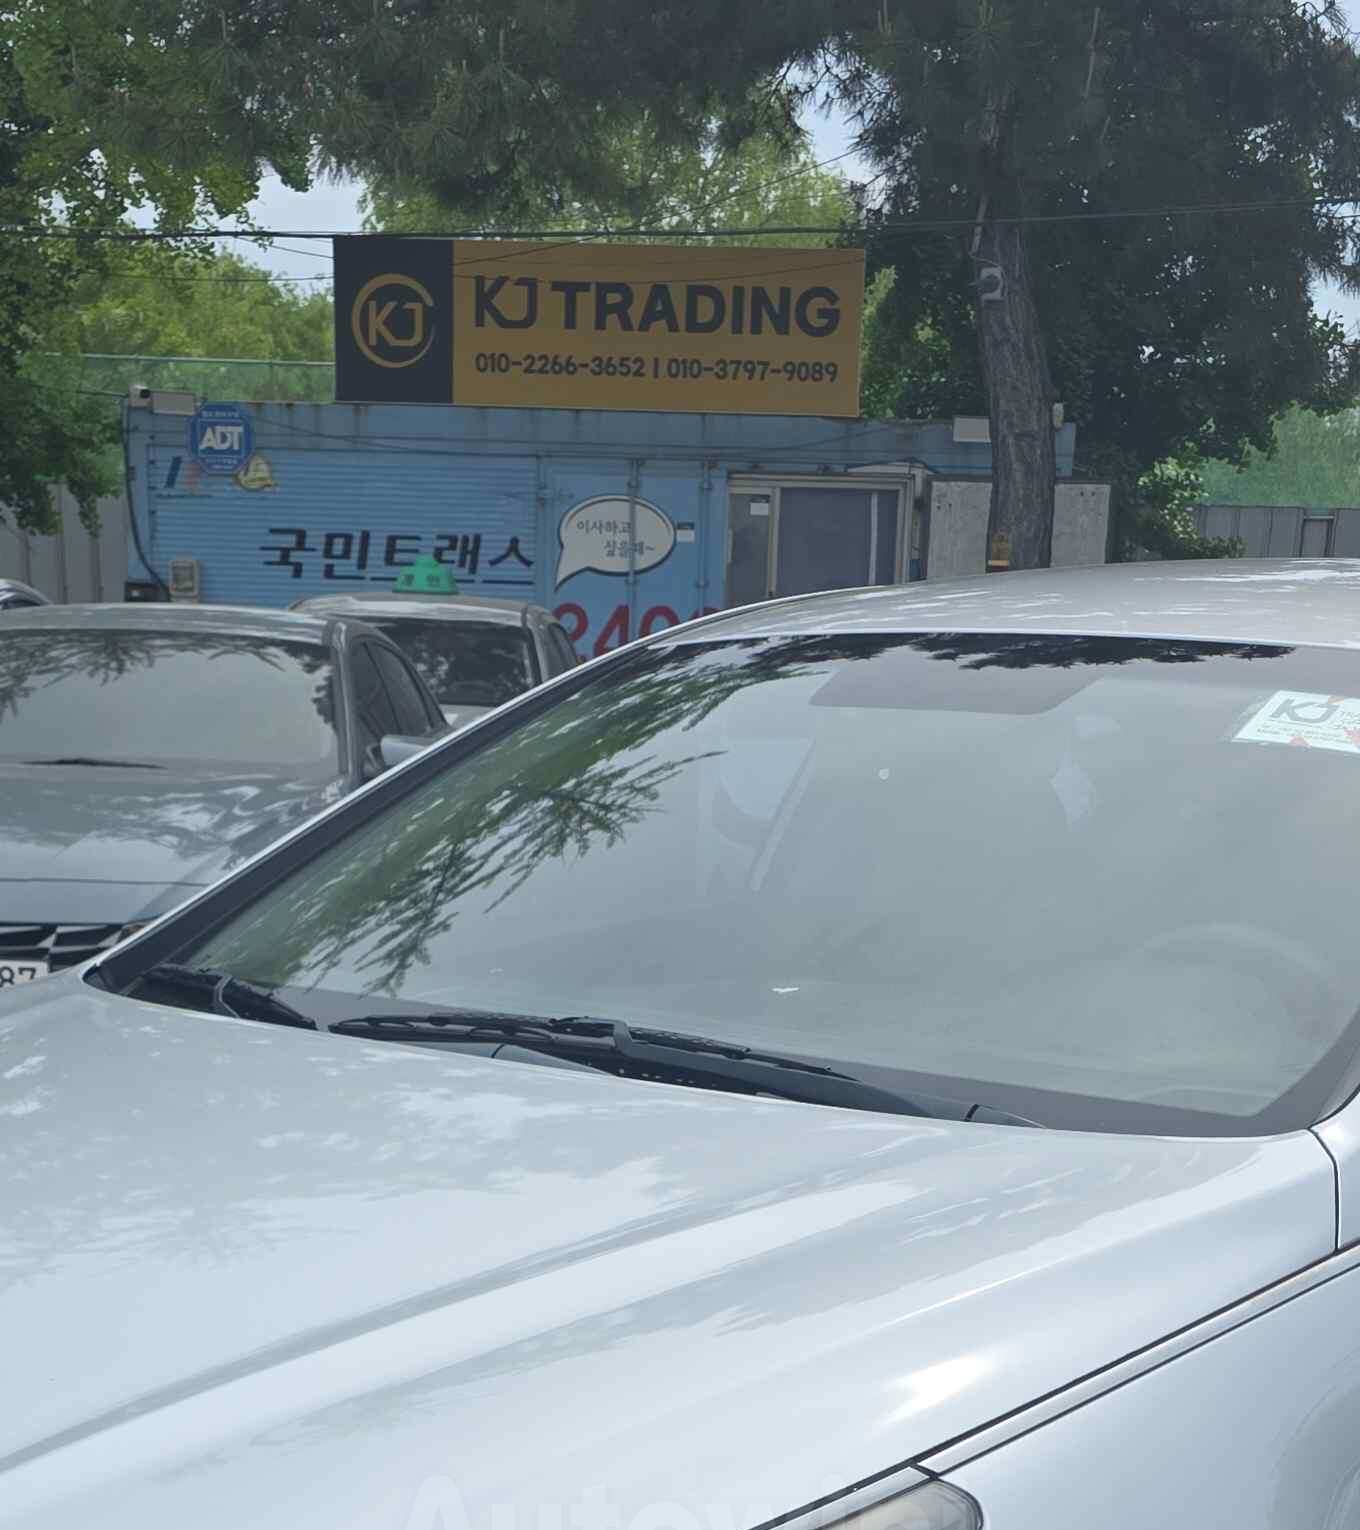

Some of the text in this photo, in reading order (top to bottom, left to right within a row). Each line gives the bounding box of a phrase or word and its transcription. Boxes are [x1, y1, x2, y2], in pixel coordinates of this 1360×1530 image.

[367, 300, 424, 347] KJ
[474, 275, 841, 338] KJ TRADING
[475, 352, 645, 379] 010-2266-3652
[666, 358, 838, 383] 010-3797-9089
[199, 425, 245, 451] ADT
